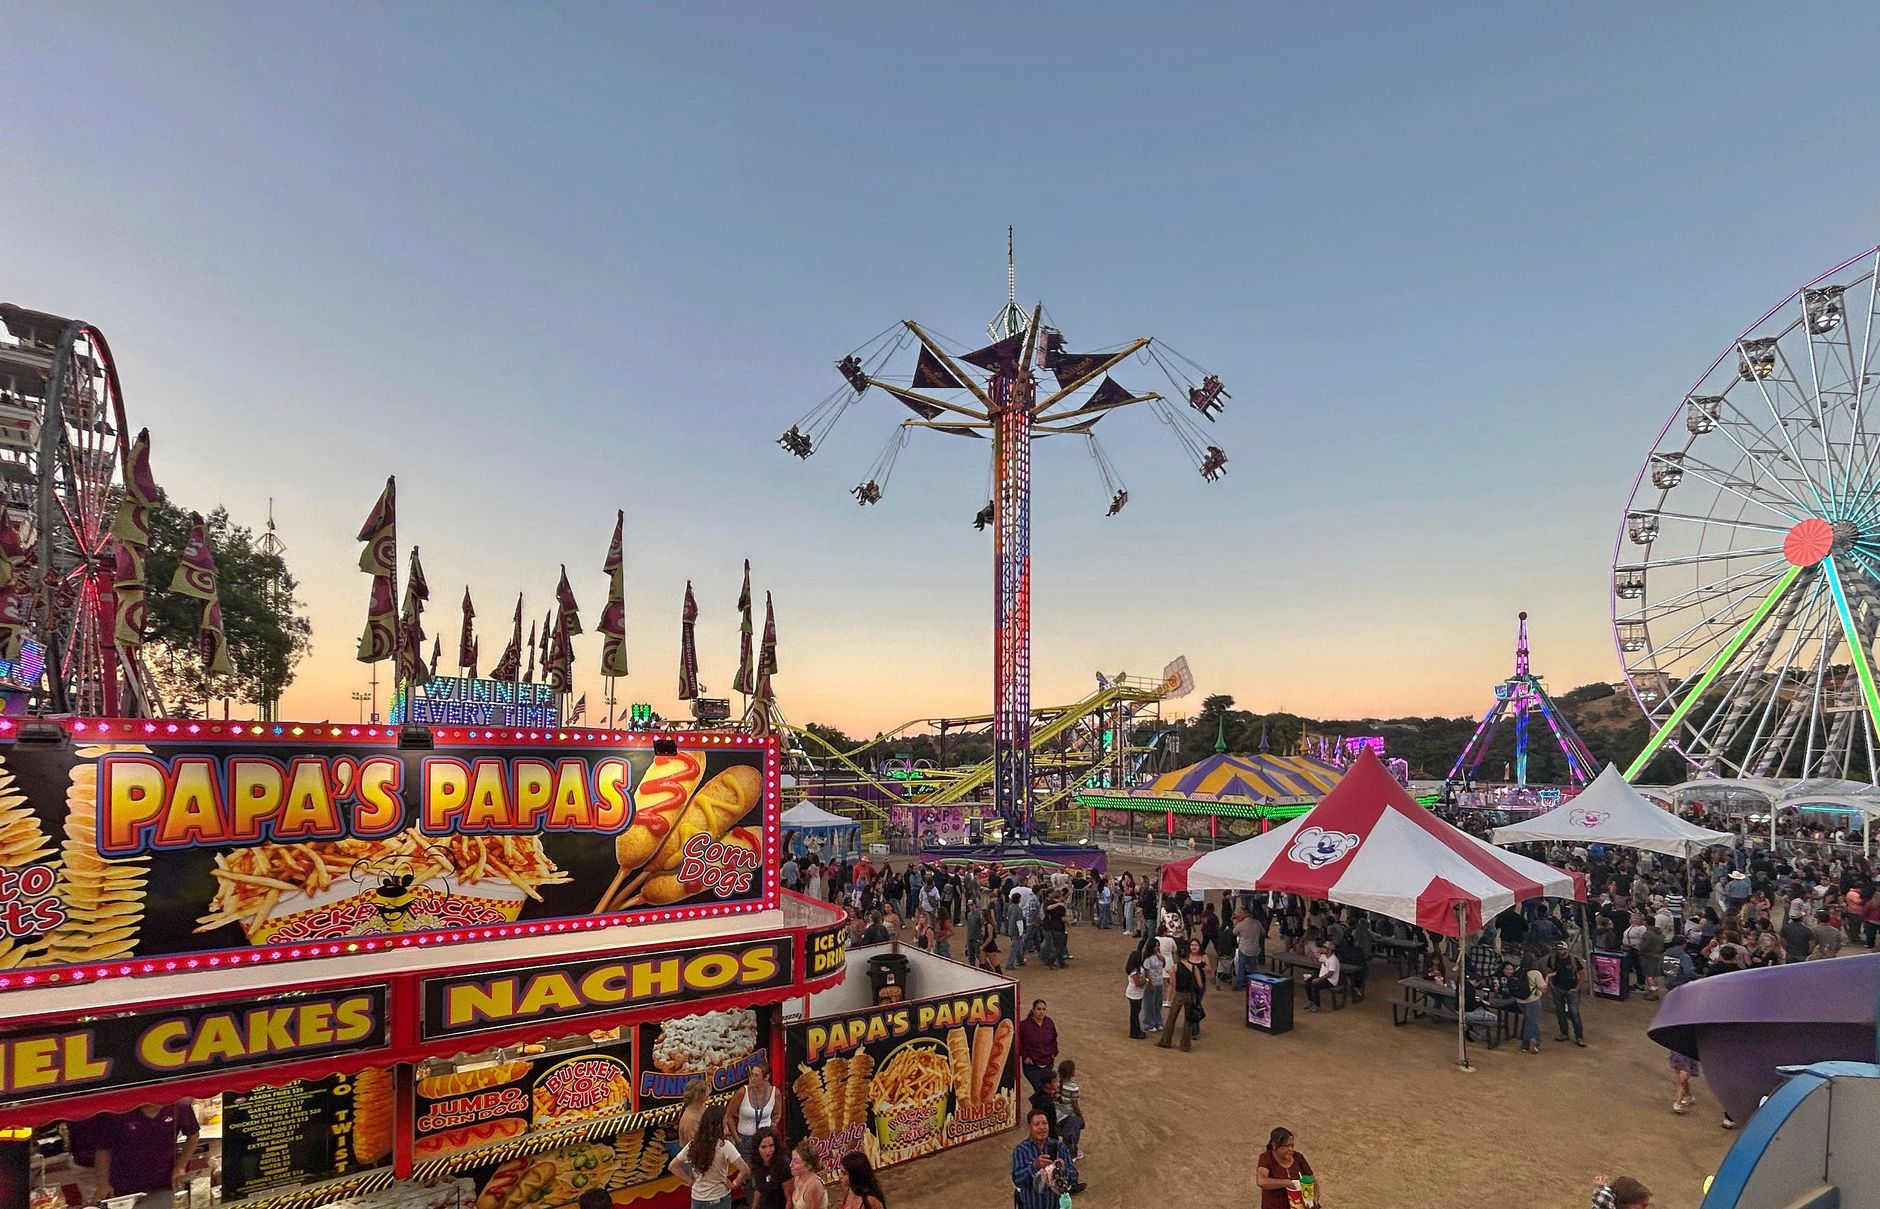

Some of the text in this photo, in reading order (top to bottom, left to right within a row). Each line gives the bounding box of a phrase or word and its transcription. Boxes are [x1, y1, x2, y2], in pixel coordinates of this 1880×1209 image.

[424, 675, 554, 705] WINNER
[413, 699, 558, 728] EVERY TIME
[100, 755, 629, 854] PAPA'S PAPAS
[684, 833, 757, 868] Corn
[678, 858, 752, 897] Dogs
[0, 897, 65, 937] ts
[814, 933, 835, 952] ICE
[814, 945, 846, 972] DRIN
[448, 947, 777, 1027] NACHOS
[140, 997, 373, 1068] CAKES
[807, 993, 1002, 1062] PAPA'S PAPAS
[546, 1060, 621, 1094] BUCKET
[642, 1072, 707, 1097] FUNN
[247, 1105, 272, 1114] GARLIC
[429, 1087, 523, 1117] JUMBO
[557, 1082, 612, 1110] FRIES
[954, 1097, 1006, 1122] JUMBO
[228, 1119, 259, 1129] CHICKEN
[260, 1115, 282, 1123] STRIPS
[241, 1122, 272, 1132] CHICKEN
[273, 1118, 295, 1127] STRIPS
[417, 1095, 529, 1132] CORN DOGS
[247, 1141, 269, 1149] EXTRA
[270, 1136, 294, 1145] RANCH
[250, 1129, 270, 1137] CORN
[256, 1132, 285, 1141] NACHOS
[331, 1109, 352, 1172] TWIST
[948, 1121, 979, 1138] CORN
